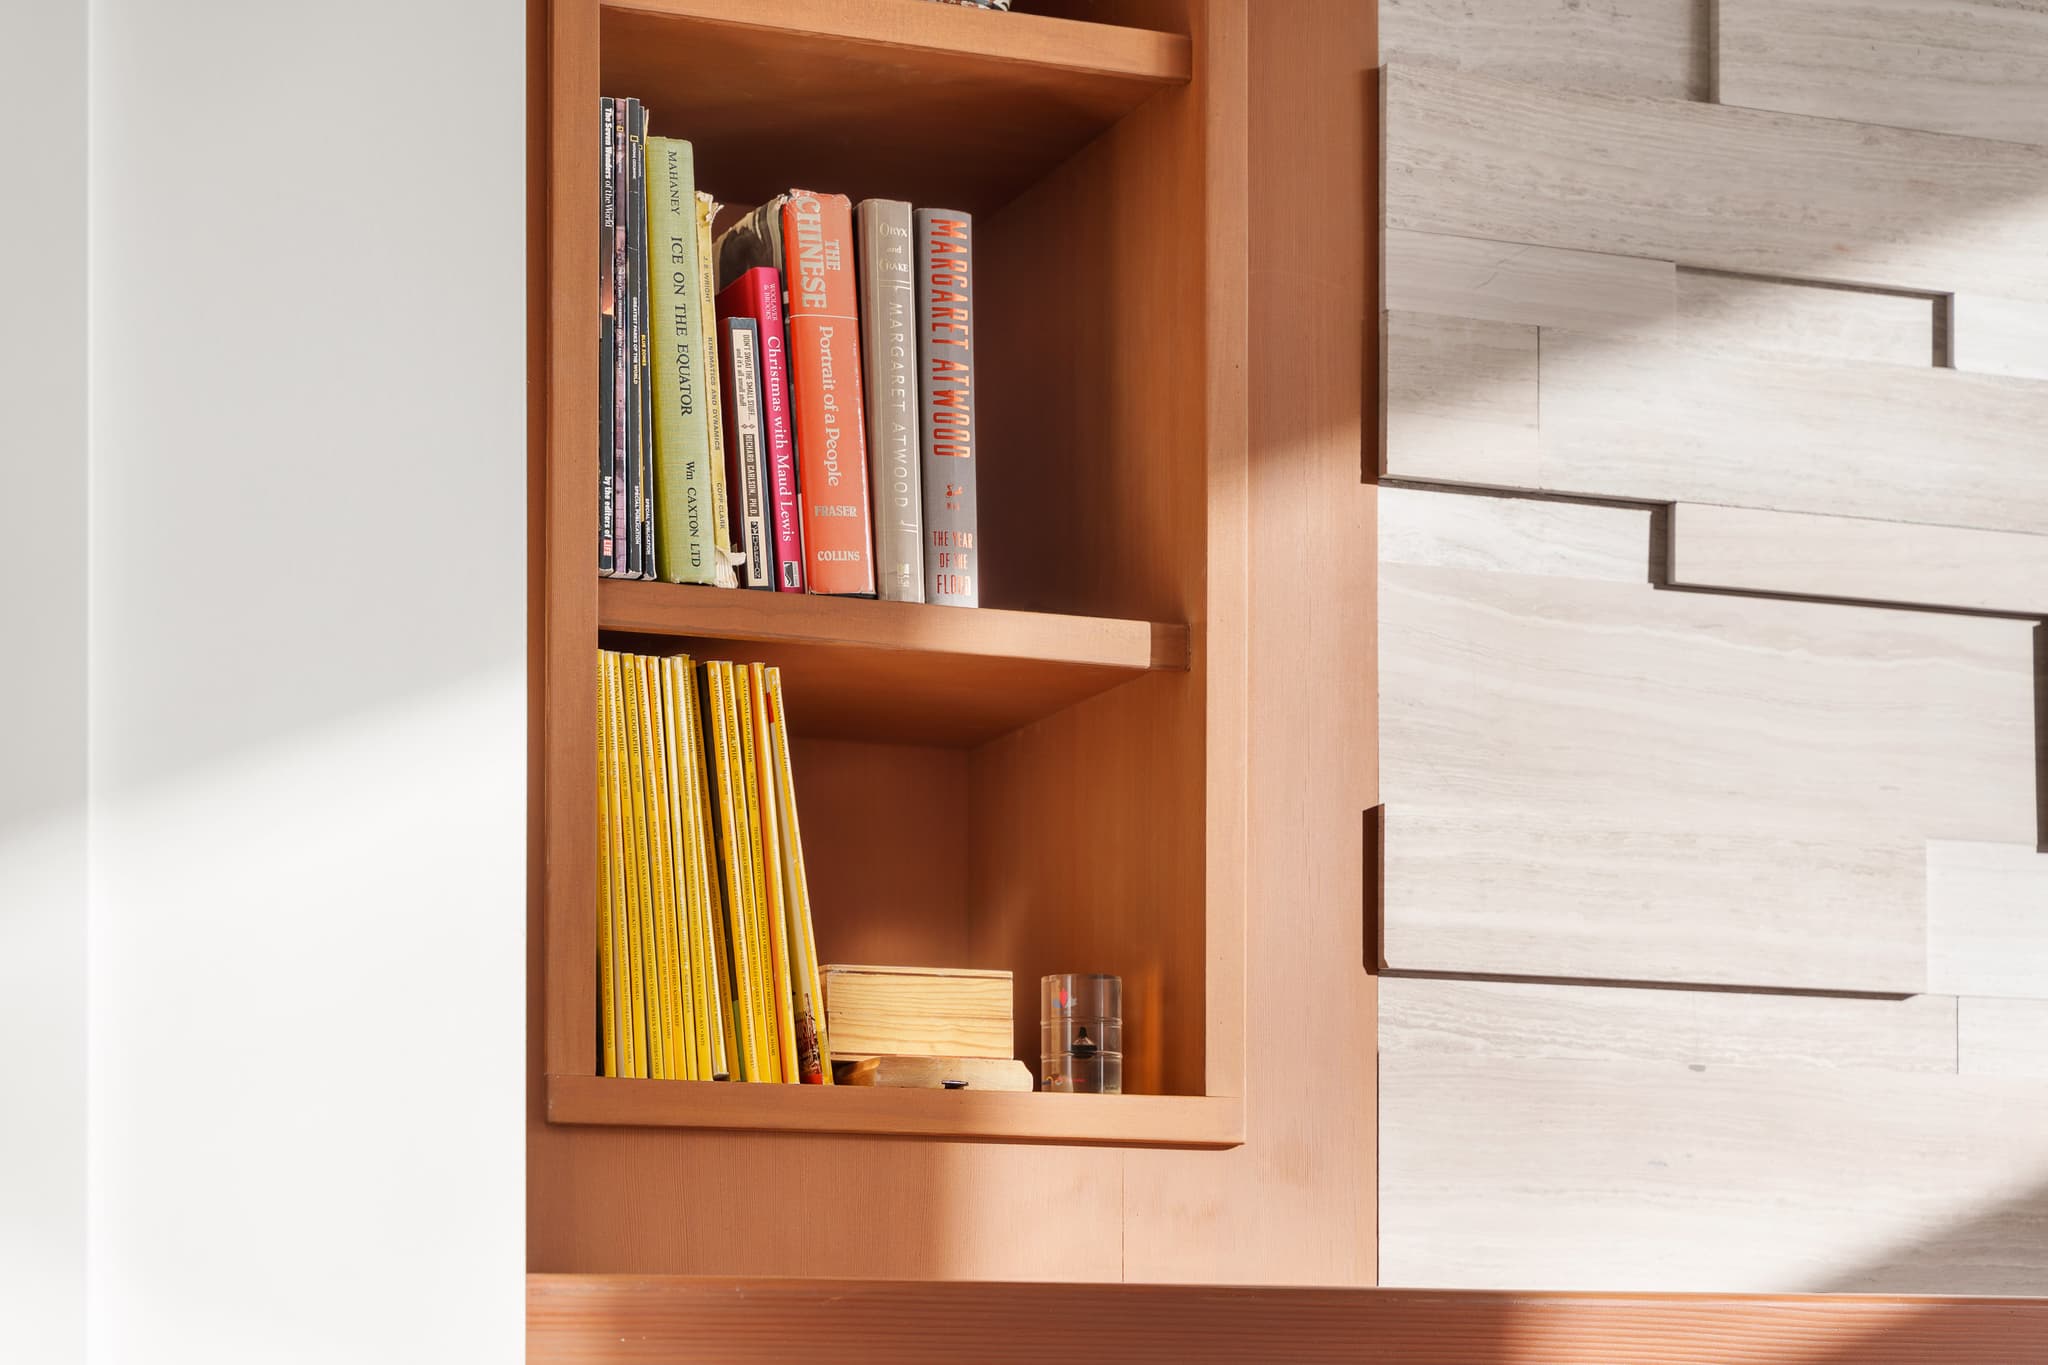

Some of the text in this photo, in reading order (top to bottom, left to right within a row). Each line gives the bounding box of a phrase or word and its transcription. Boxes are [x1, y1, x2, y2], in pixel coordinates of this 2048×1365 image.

[604, 108, 612, 228] The Seven Wonders of the World
[668, 150, 680, 216] MAHANEY
[796, 196, 827, 308] CHINESE
[826, 240, 840, 270] THE
[886, 246, 902, 254] and
[769, 283, 778, 320] WOOLAVER
[930, 218, 968, 350] MARGARET
[670, 236, 693, 416] ICE ON THE EQUATOR
[744, 352, 752, 368] SWEAT
[708, 337, 716, 386] KINEMATICS
[712, 408, 720, 450] DYNAMICS
[738, 378, 746, 392] small
[746, 382, 754, 399] SMALL
[819, 326, 842, 487] Portrait of a People
[889, 302, 908, 507] MARGARET ATWOOD
[931, 358, 972, 458] ATWOOD
[745, 434, 754, 462] RICHARD
[768, 336, 794, 542] Christmas with Maud Lewis
[604, 476, 612, 556] by the editors of LIFE
[685, 461, 701, 568] Wm CAXTON LTD
[748, 498, 758, 516] PH.D.
[814, 506, 858, 518] FRASER
[818, 550, 860, 562] COLLINS
[932, 530, 973, 549] THE YEAR
[939, 552, 950, 568] OF
[936, 574, 971, 596] FLOOD
[630, 708, 638, 756] GEOGRAPHIC
[728, 715, 737, 760] GEOGRAPHIC
